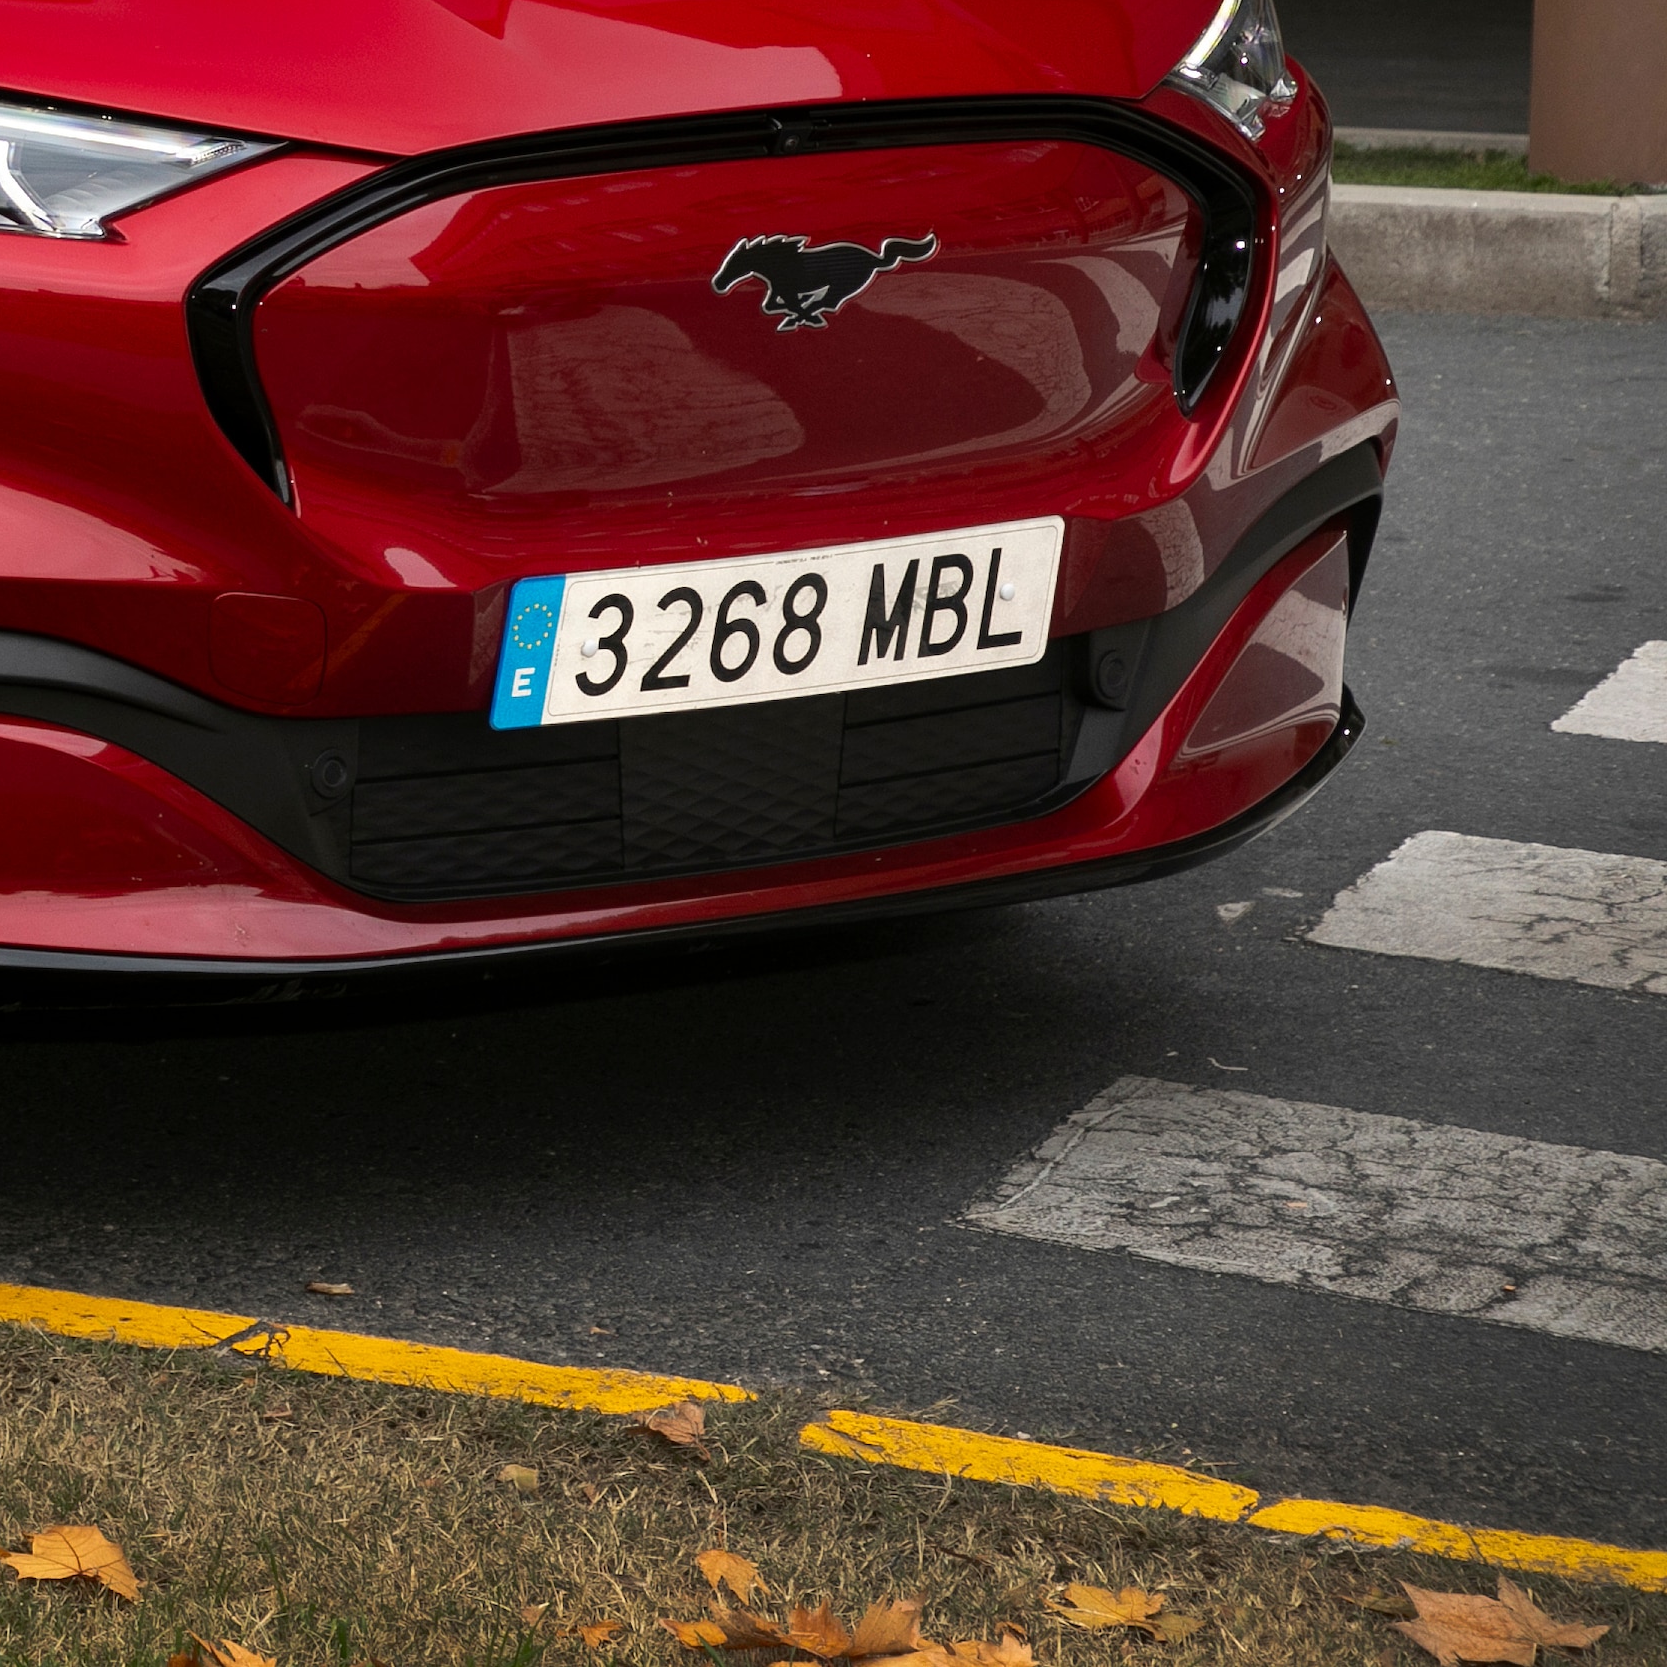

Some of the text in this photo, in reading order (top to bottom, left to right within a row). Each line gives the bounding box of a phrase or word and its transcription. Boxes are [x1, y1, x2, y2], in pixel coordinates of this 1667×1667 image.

[574, 547, 1024, 697] 3268 MBL
[510, 667, 535, 698] E
